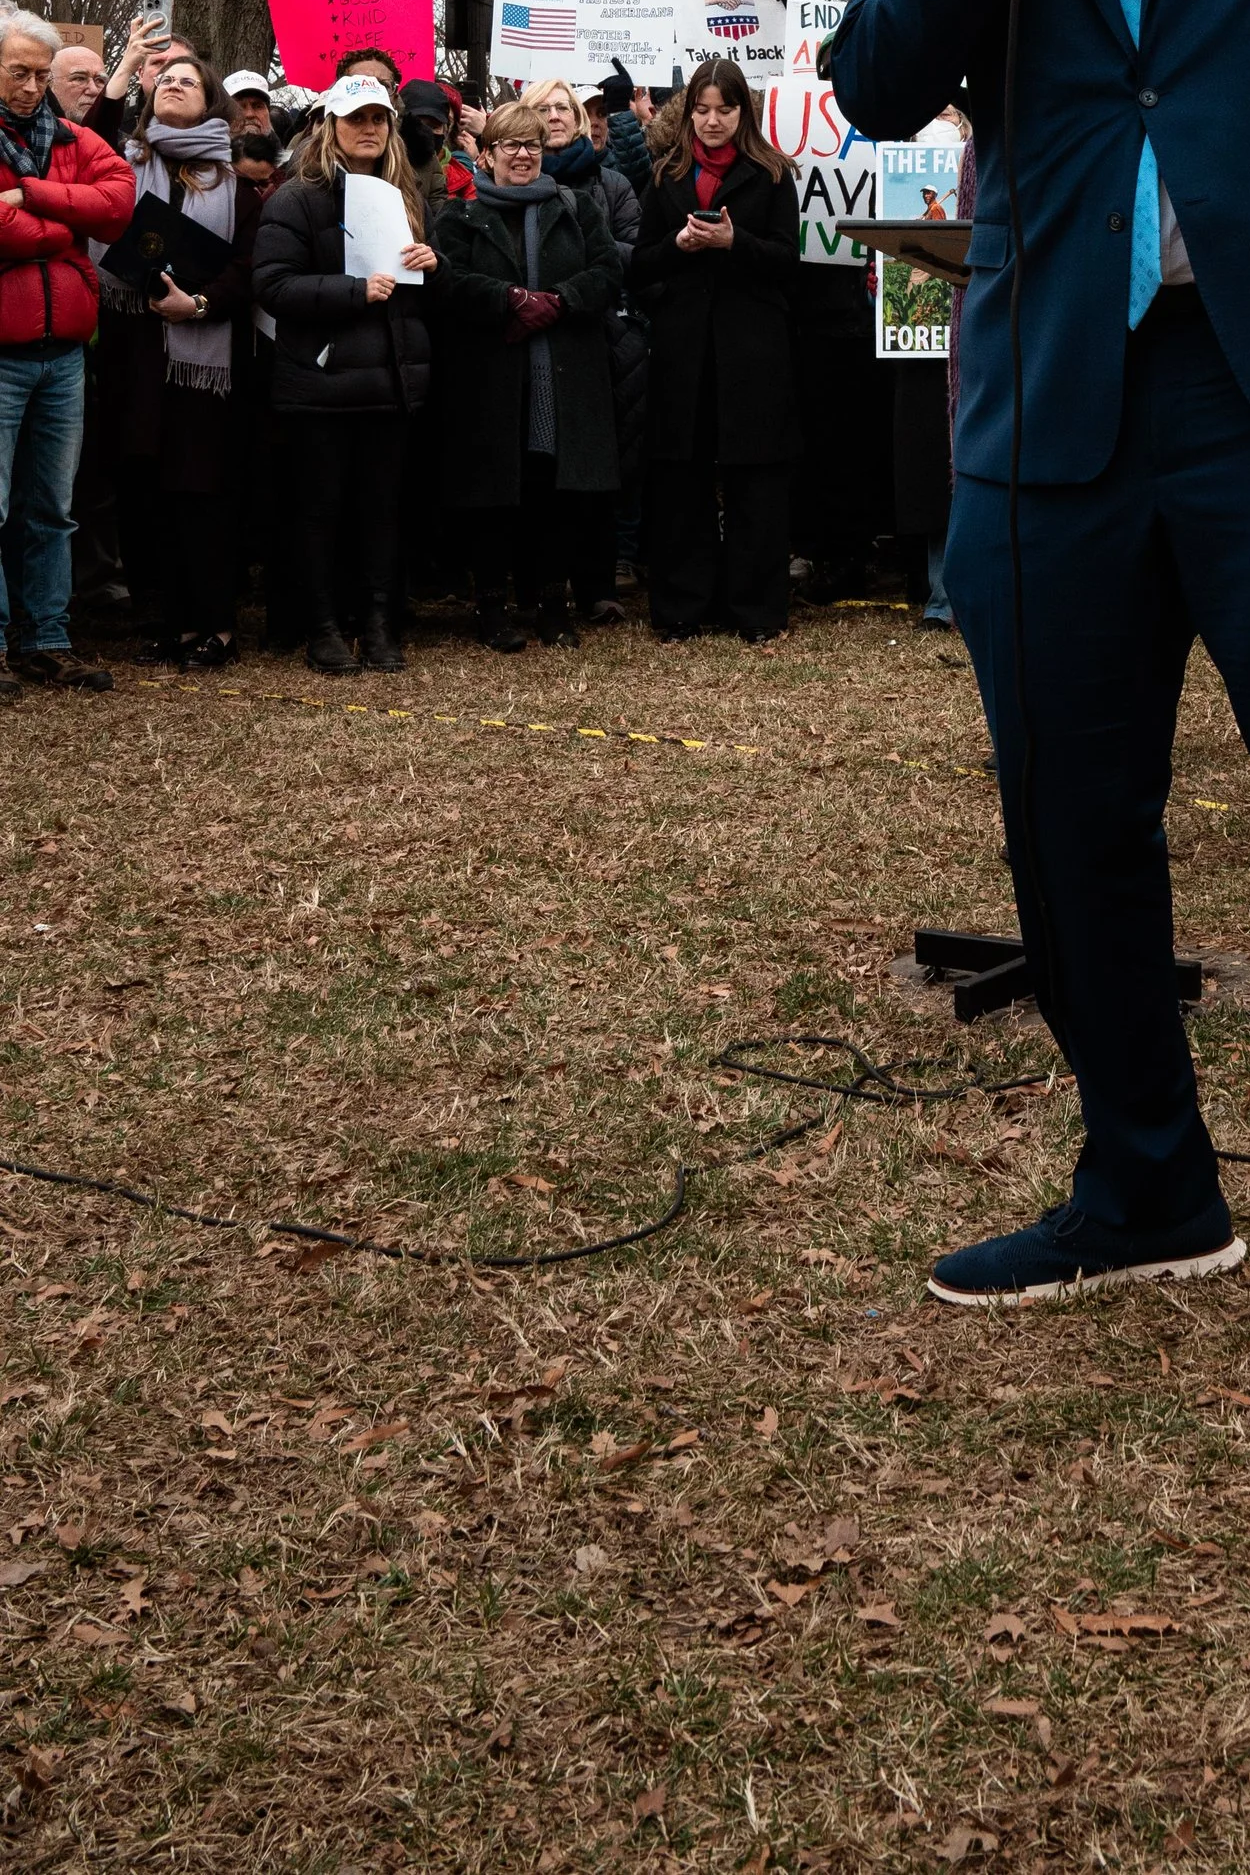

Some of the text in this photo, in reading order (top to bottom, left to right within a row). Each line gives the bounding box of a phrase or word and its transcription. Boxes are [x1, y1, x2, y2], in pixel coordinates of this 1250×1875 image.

[342, 9, 387, 26] KIND
[600, 6, 674, 19] AMERICANS
[344, 30, 384, 47] SAFE
[576, 28, 631, 40] FOSTERS
[588, 40, 652, 52] GOODWILL
[727, 46, 740, 62] it
[884, 149, 960, 174] THE FA
